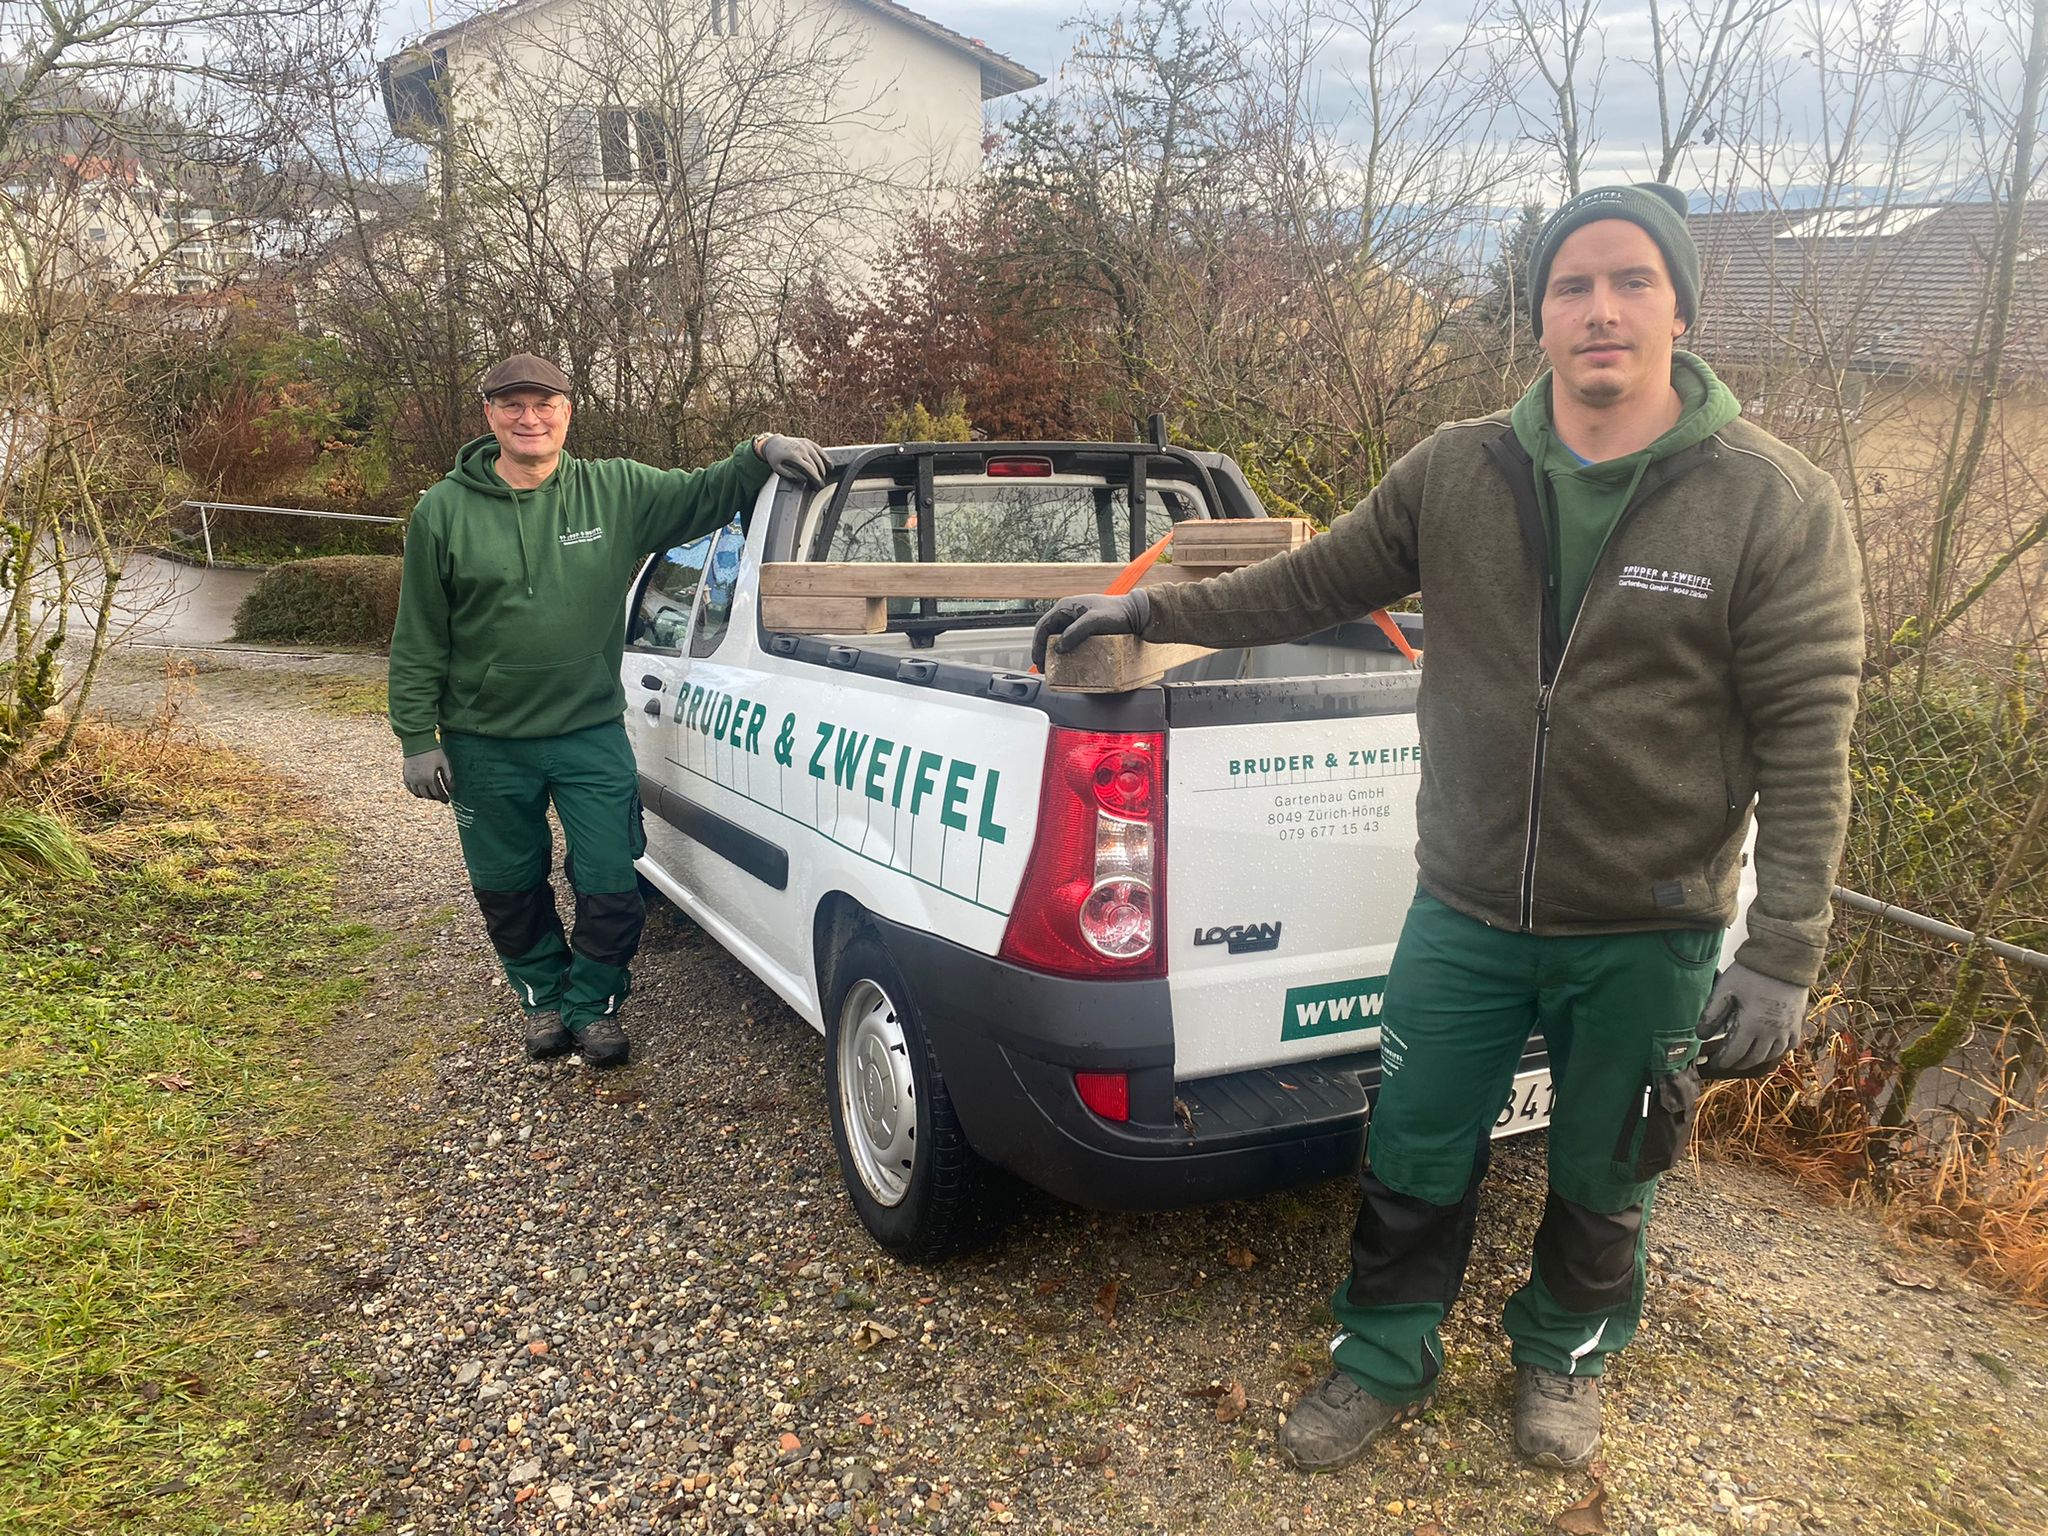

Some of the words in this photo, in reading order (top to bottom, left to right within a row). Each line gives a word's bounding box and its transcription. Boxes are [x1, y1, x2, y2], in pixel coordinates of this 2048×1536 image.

[1671, 571, 1712, 586] ZWEIFEL
[673, 681, 767, 755] BRUDER
[774, 712, 796, 768] &
[808, 721, 1006, 844] ZWEIFEL
[1229, 754, 1315, 776] BRUDER
[1325, 752, 1338, 768] &
[1348, 746, 1420, 766] ZWEIFE
[1274, 793, 1343, 807] Gartenbau
[1348, 787, 1384, 801] GmbH
[1267, 811, 1302, 825] 8049
[1308, 804, 1391, 821] Zürich-Höngg
[1279, 828, 1305, 841] 079
[1311, 825, 1335, 838] 677
[1342, 823, 1358, 835] 15
[1363, 821, 1379, 832] 43
[1193, 921, 1282, 946] LOGAN
